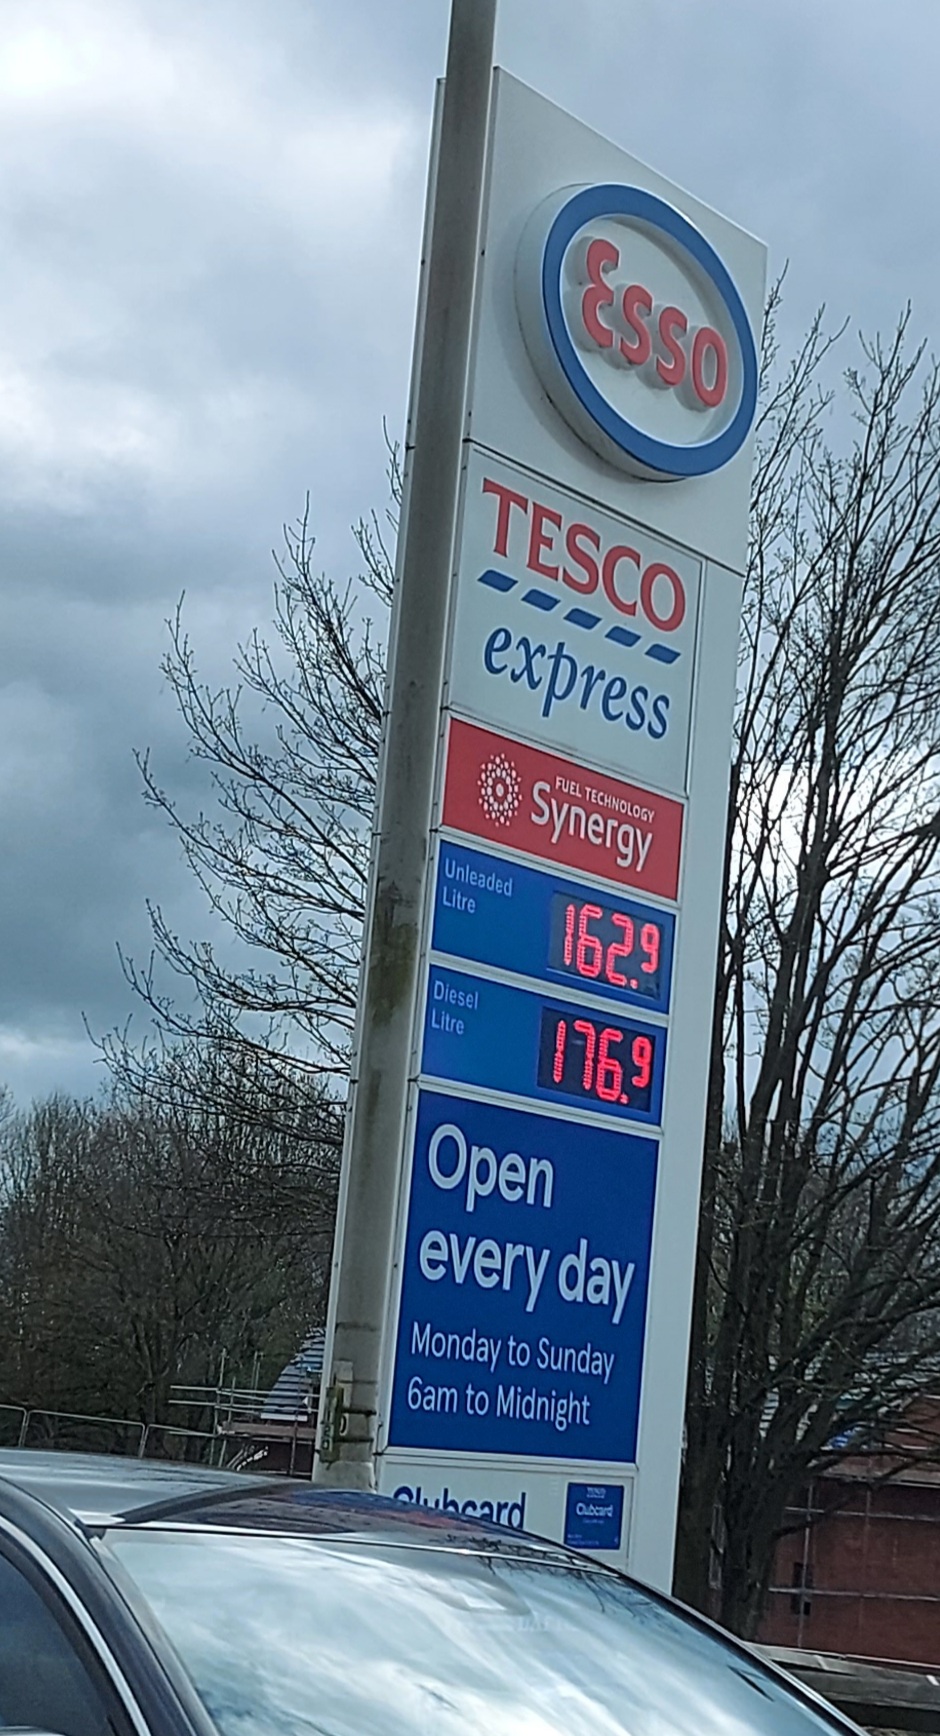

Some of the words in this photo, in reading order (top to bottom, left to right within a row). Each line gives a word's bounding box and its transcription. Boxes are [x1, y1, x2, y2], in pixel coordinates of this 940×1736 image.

[482, 477, 686, 632] TESCO
[484, 627, 670, 739] express
[531, 781, 653, 872] Synergy
[555, 776, 582, 798] FUEL
[584, 787, 655, 823] TECHNOLOGY
[442, 886, 477, 914] Litre
[444, 858, 513, 897] Unleaded
[563, 903, 660, 989] 162.9
[431, 1008, 465, 1035] Litre
[433, 980, 478, 1010] Diesel
[553, 1019, 652, 1104] 176.9
[428, 1123, 554, 1212] Open
[419, 1230, 550, 1312] every
[558, 1238, 635, 1324] day
[411, 1321, 501, 1373] Monday
[507, 1335, 531, 1367] to
[537, 1337, 615, 1385] Sunday
[407, 1376, 458, 1414] 6am
[466, 1383, 490, 1416] to
[496, 1384, 591, 1431] Midnight
